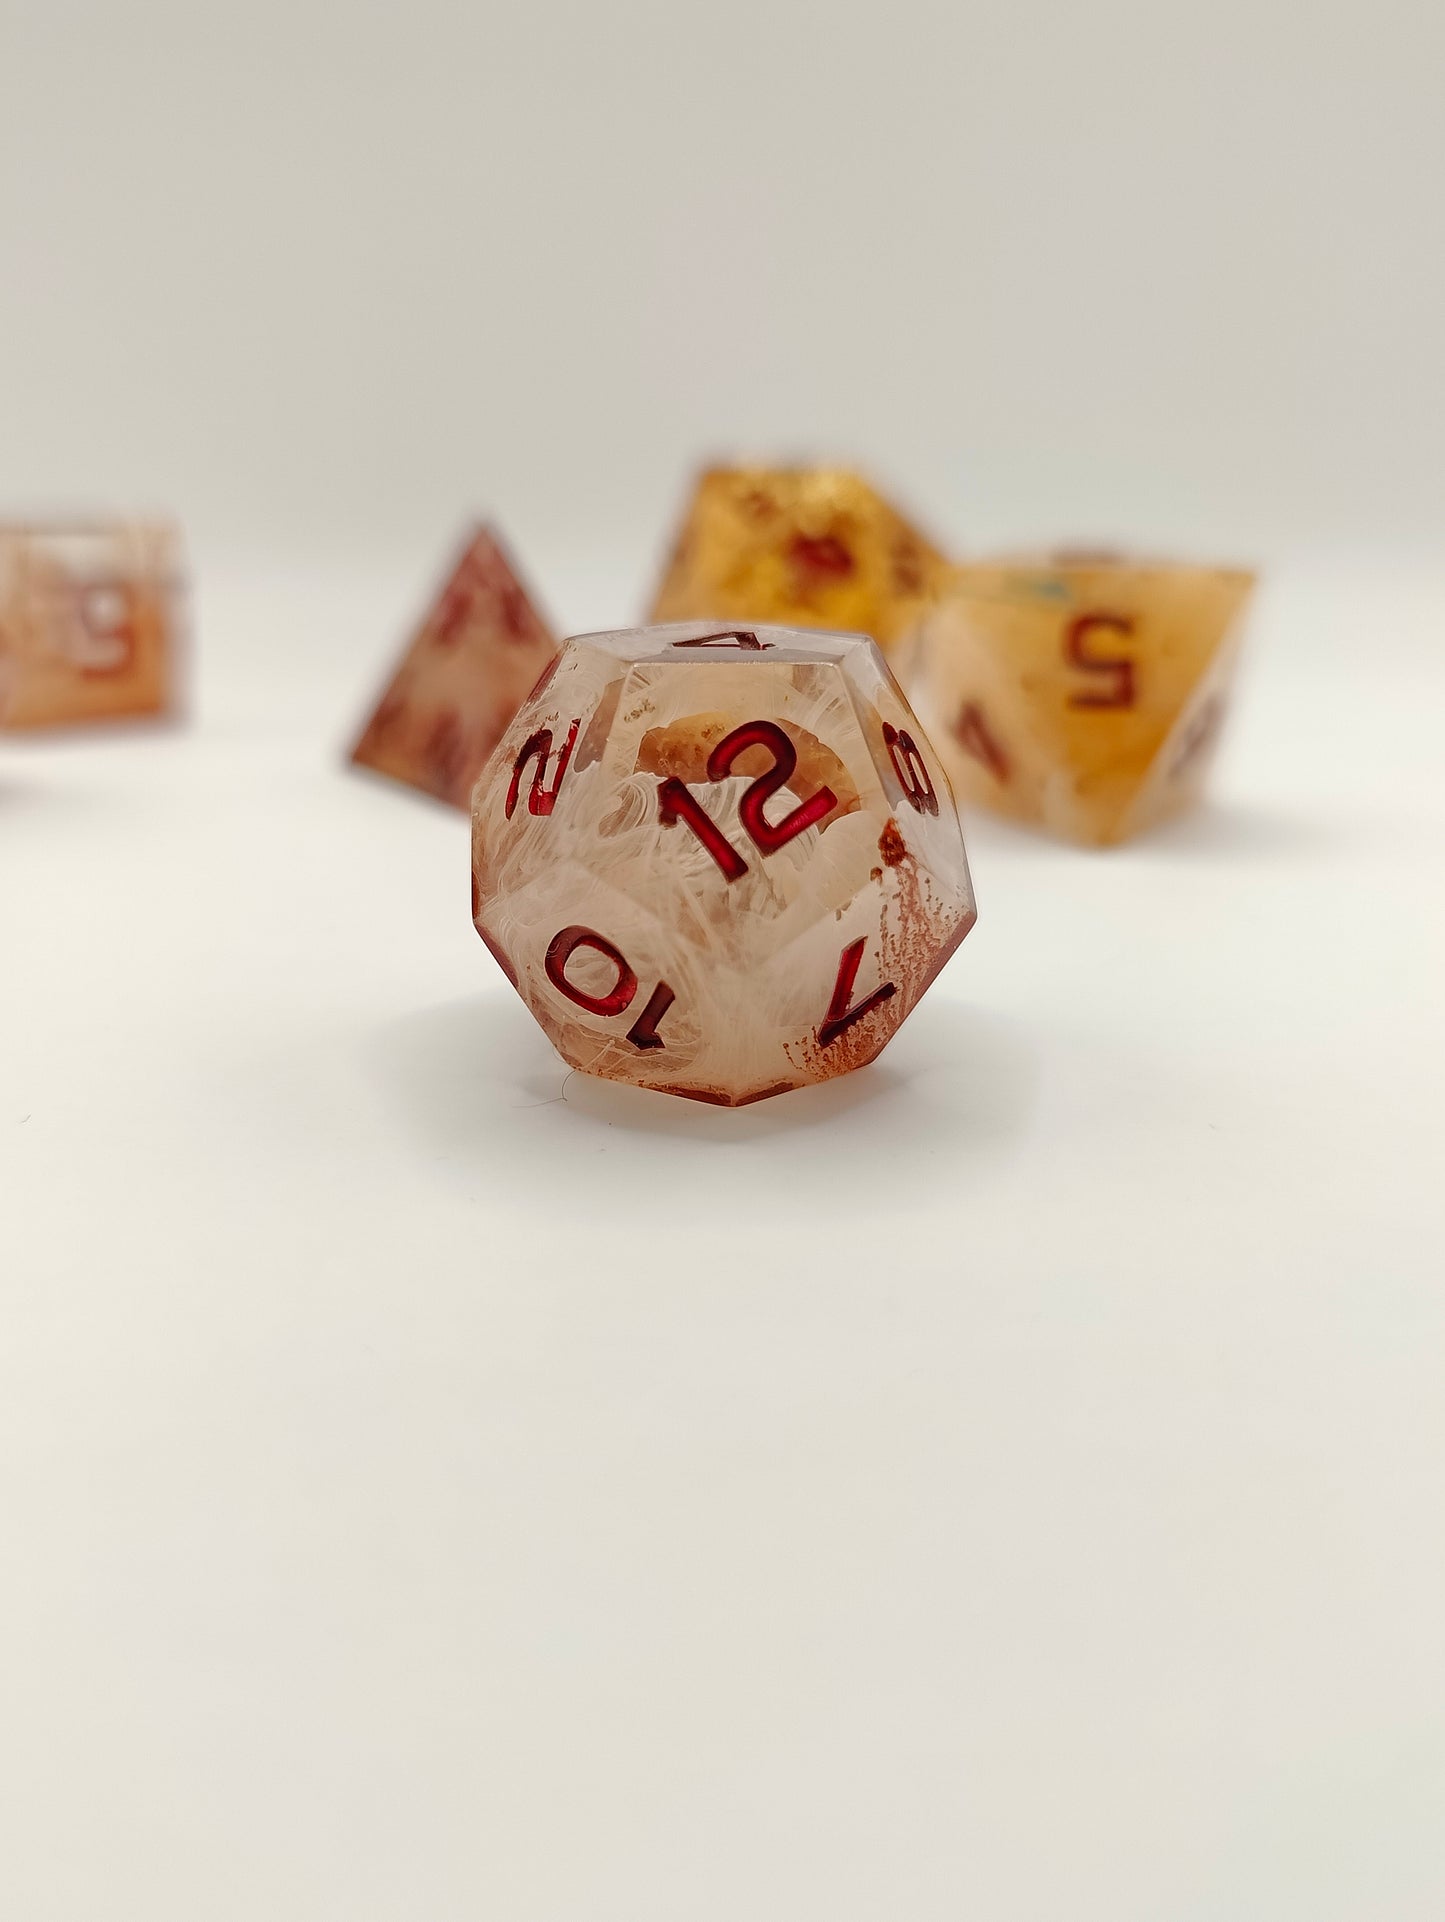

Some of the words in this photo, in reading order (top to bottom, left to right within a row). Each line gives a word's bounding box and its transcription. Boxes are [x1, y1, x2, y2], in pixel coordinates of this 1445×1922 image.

[672, 631, 775, 651] 4
[1063, 609, 1136, 713] 5
[657, 720, 838, 884] 12
[544, 924, 676, 1051] 10
[817, 935, 898, 1047] 7
